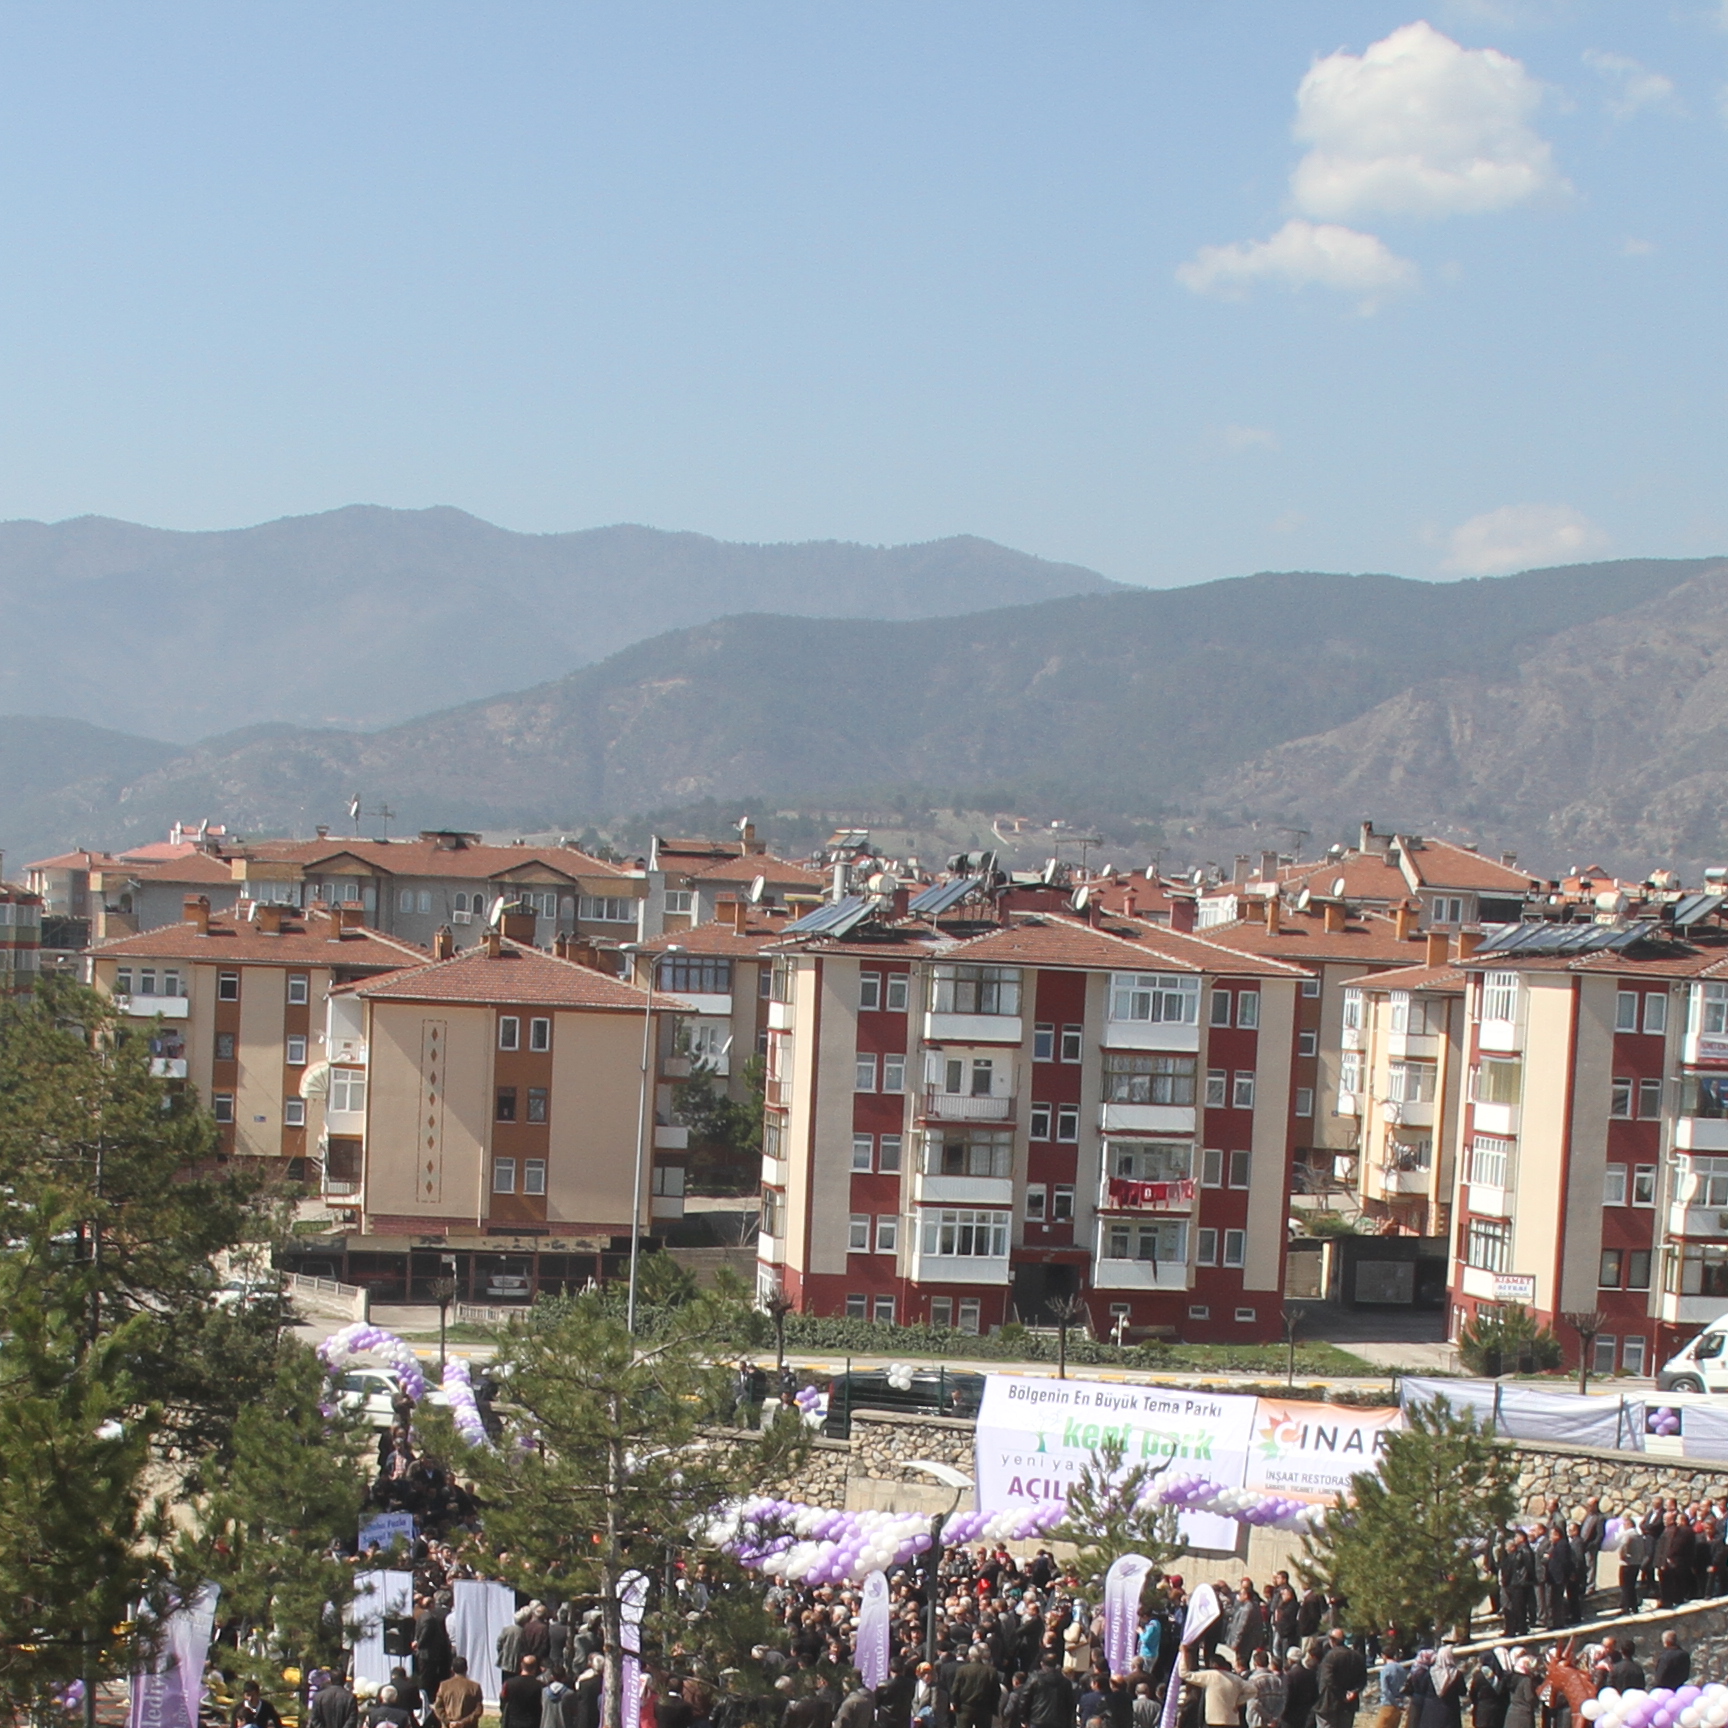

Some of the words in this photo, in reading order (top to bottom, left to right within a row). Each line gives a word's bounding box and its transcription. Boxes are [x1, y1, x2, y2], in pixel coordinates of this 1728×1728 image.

[1008, 1384, 1069, 1406] Bölgenin
[1074, 1390, 1090, 1406] En
[1094, 1392, 1138, 1412] Büyük
[1143, 1396, 1180, 1414] Tema
[1184, 1400, 1222, 1418] Parkı
[1062, 1416, 1134, 1454] kent
[1140, 1427, 1215, 1461] park
[1001, 1453, 1044, 1468] yeni
